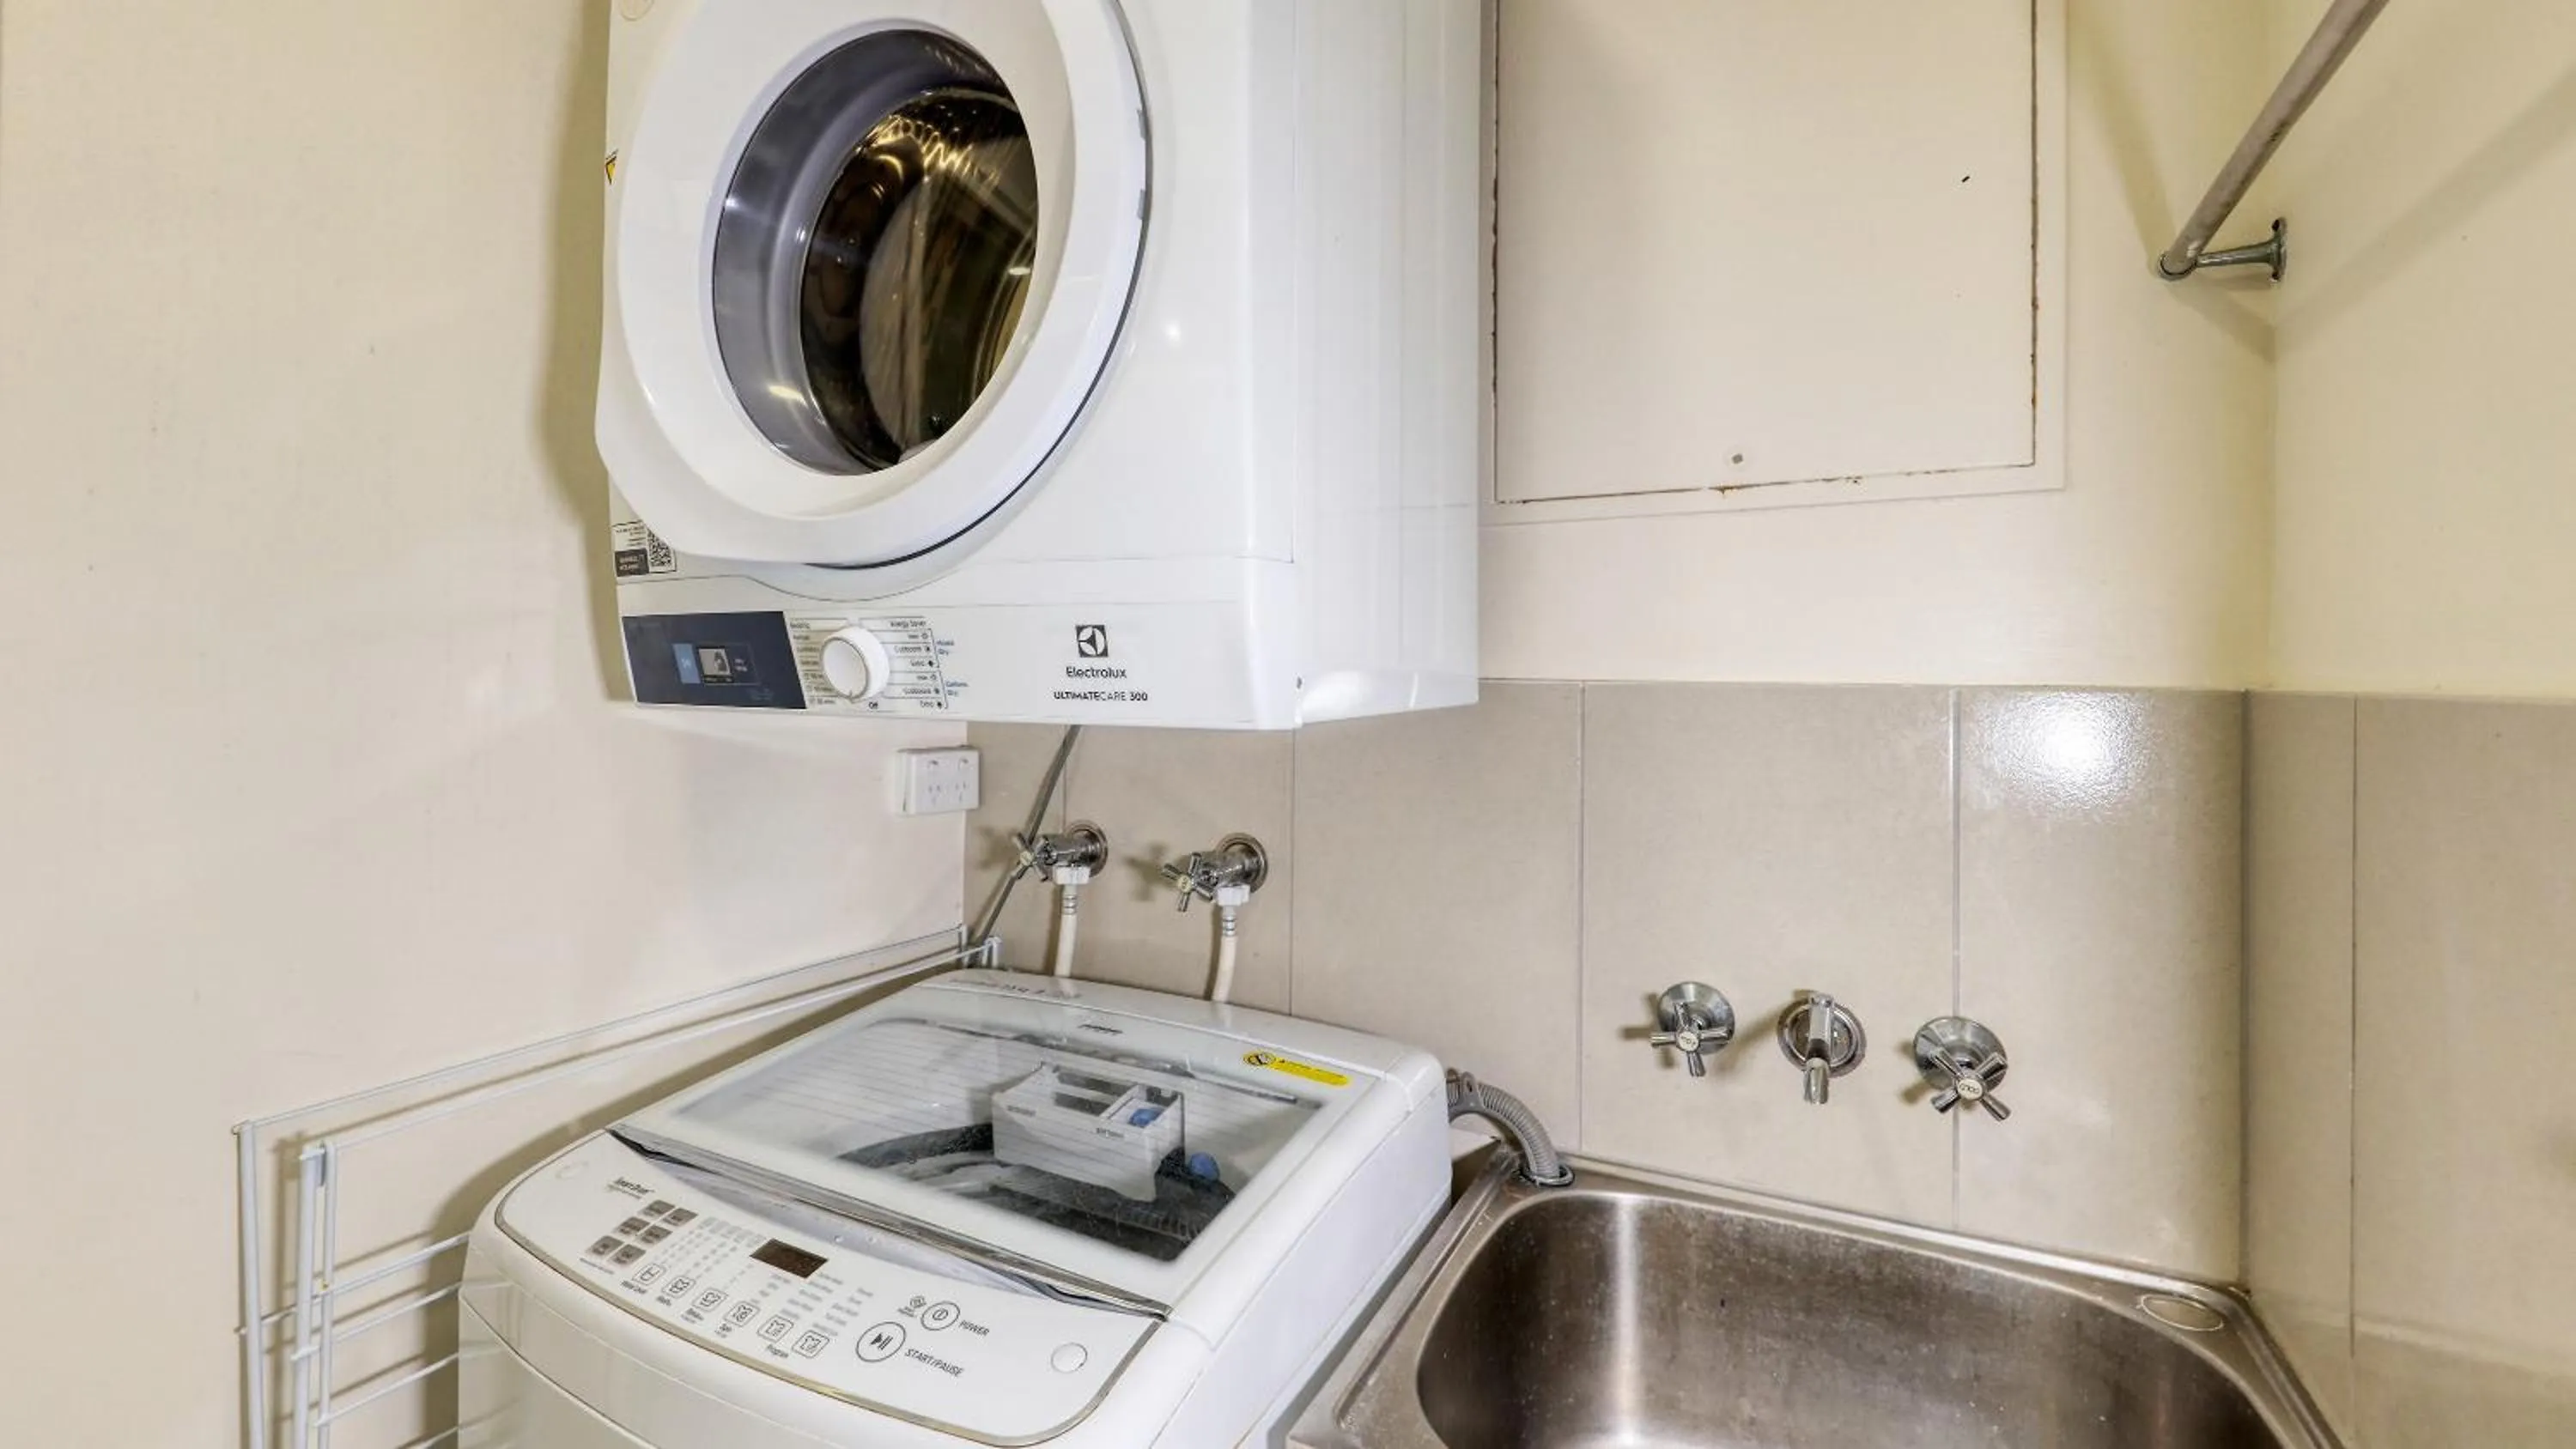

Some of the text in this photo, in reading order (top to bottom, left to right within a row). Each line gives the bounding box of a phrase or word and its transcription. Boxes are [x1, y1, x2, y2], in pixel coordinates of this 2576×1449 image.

[1065, 665, 1127, 678] Electrolux
[1053, 690, 1148, 701] ULTIMATECARE 300
[958, 1319, 990, 1337] POWER
[904, 1348, 965, 1377] START/PAUSE
